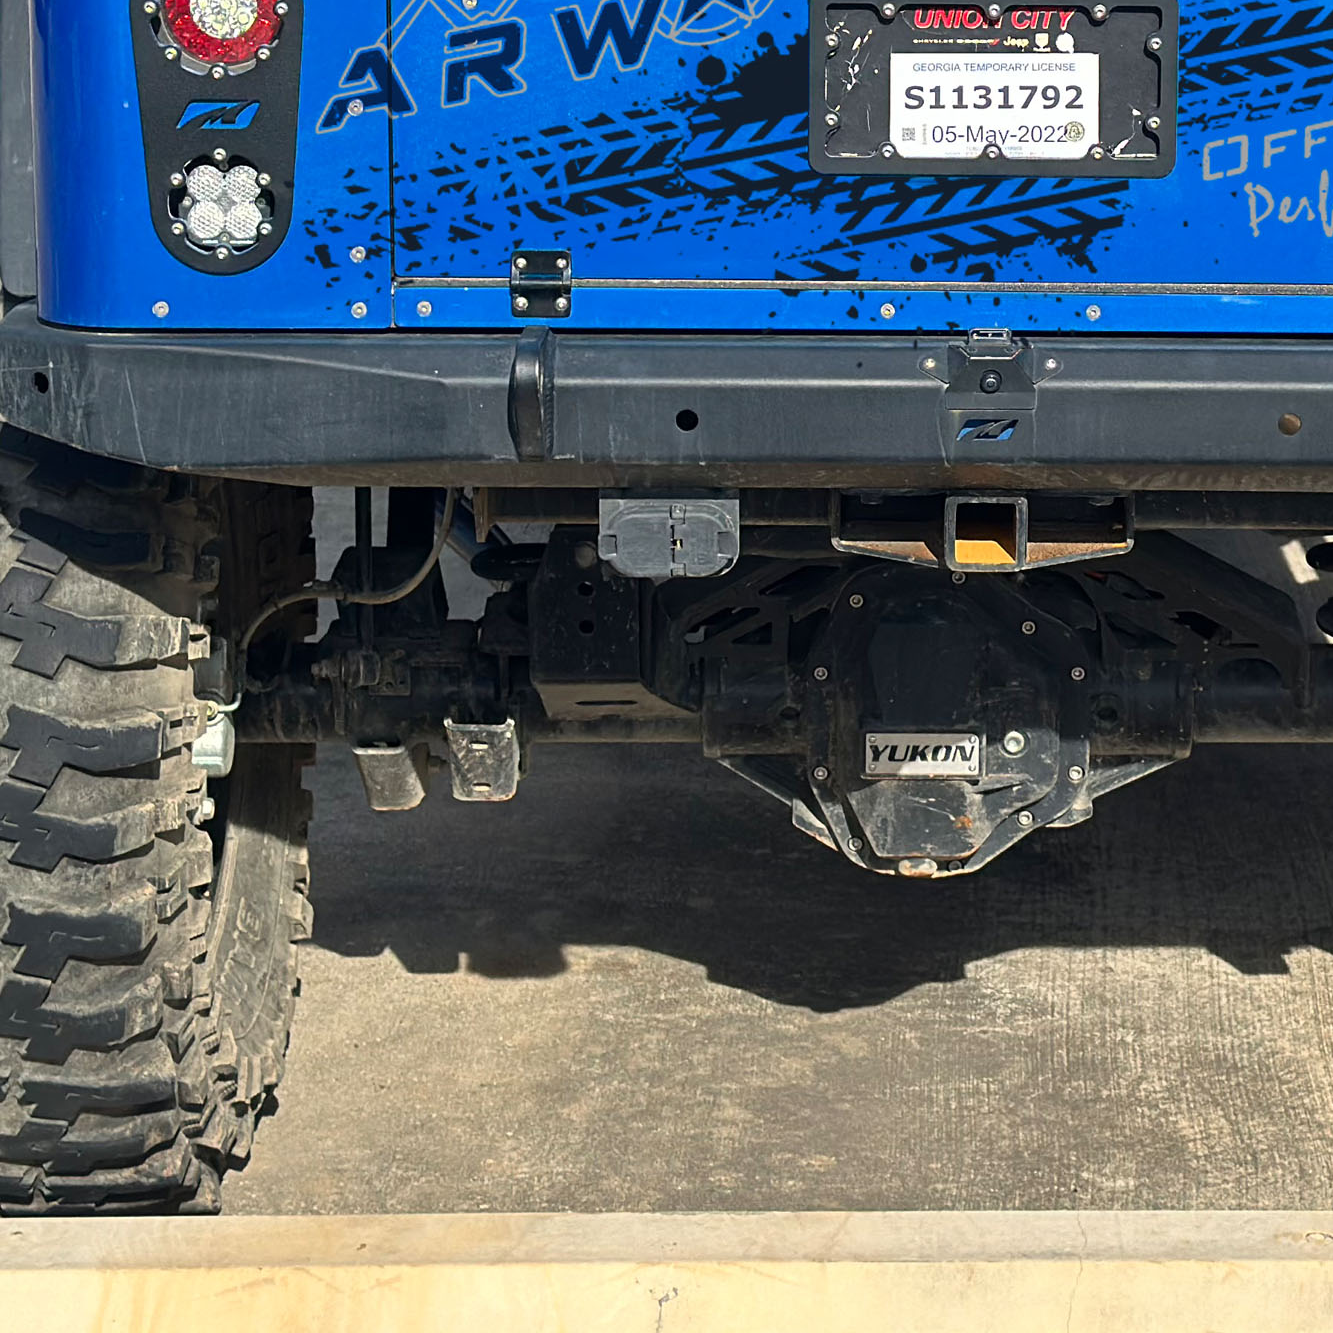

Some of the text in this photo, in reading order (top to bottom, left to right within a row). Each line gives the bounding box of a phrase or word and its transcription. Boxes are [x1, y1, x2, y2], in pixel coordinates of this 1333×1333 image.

[1011, 8, 1077, 31] CITY
[912, 62, 1077, 72] GEORGIA TEMPORARY LICENSE
[904, 84, 1084, 110] S1131792
[931, 125, 1069, 146] 05-May-2022
[869, 744, 975, 762] YUKON
